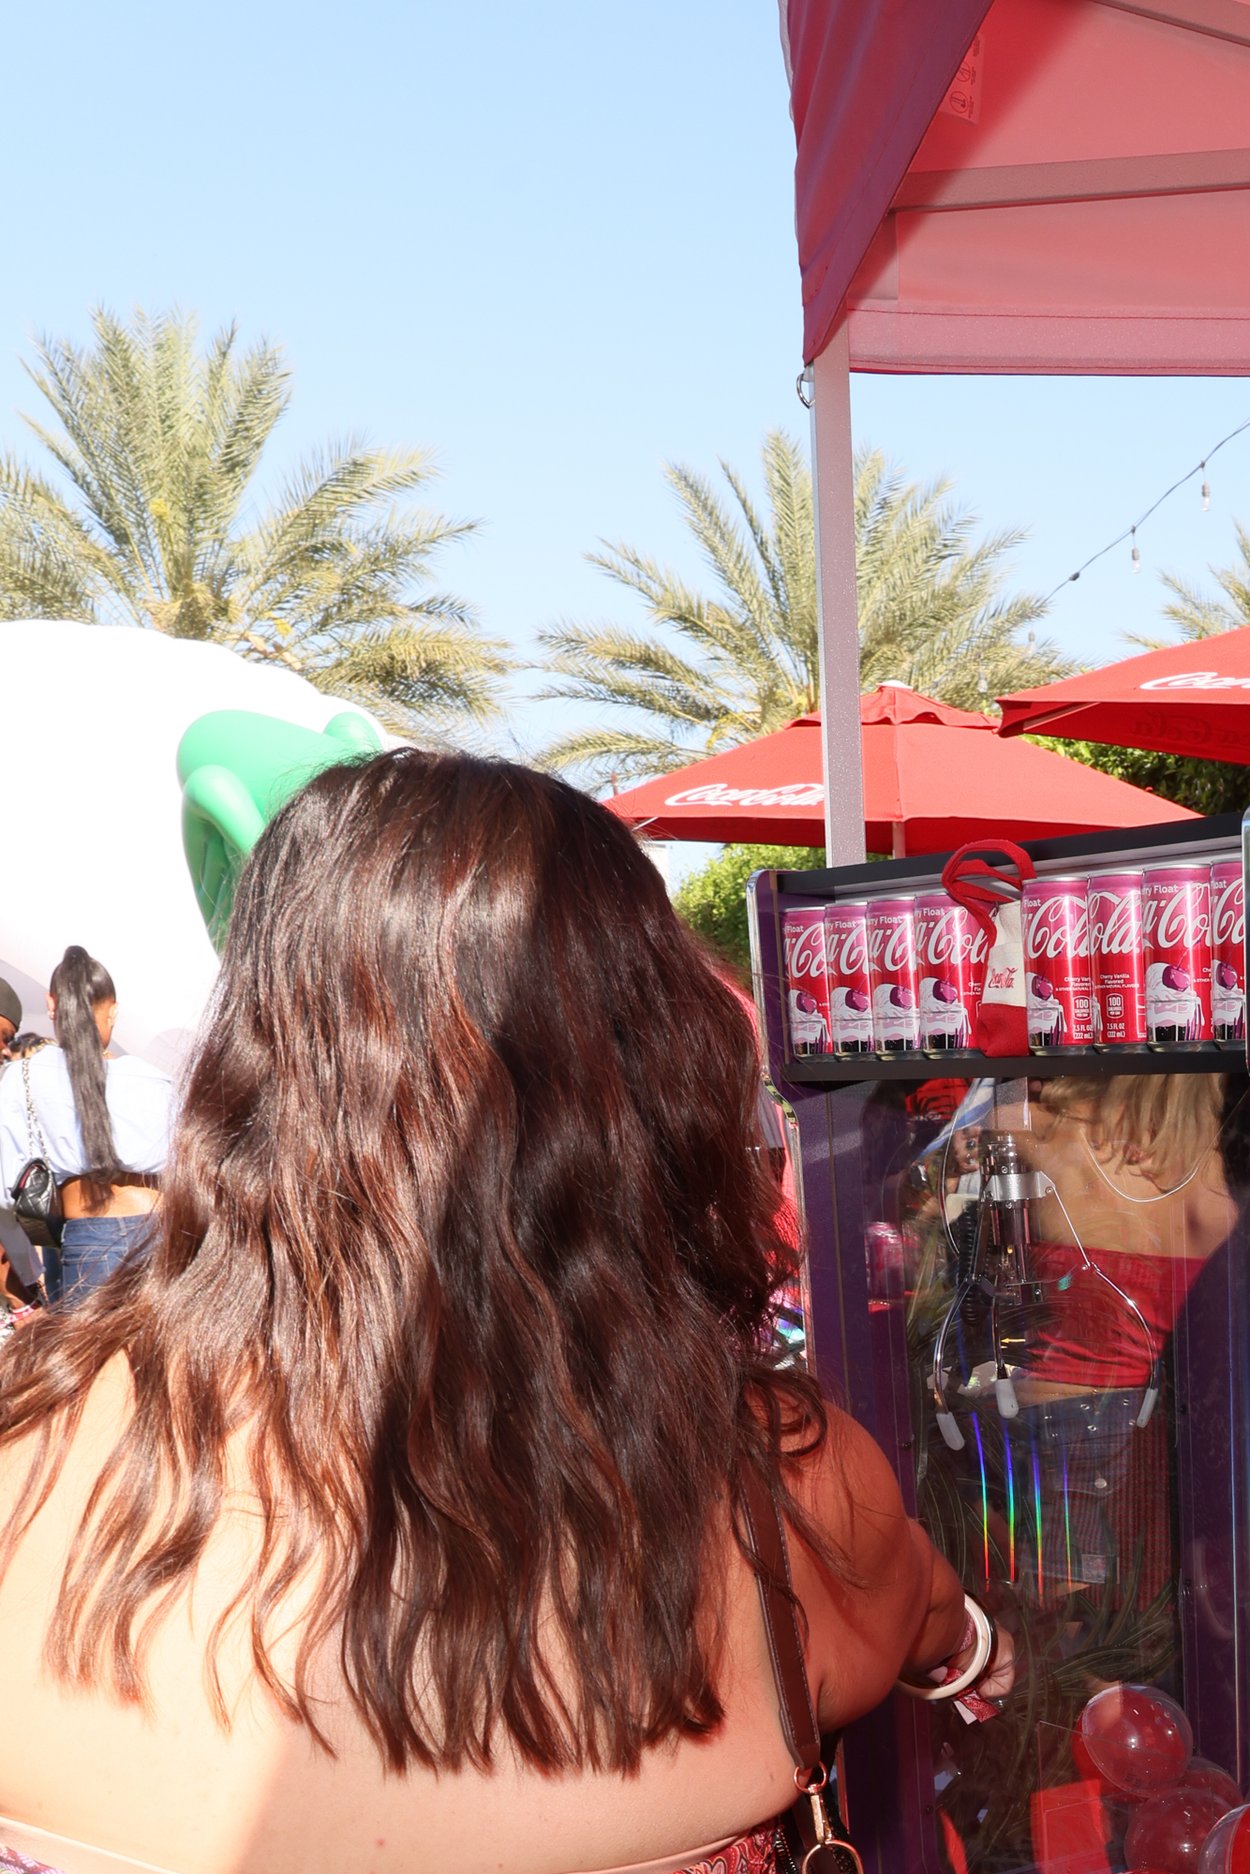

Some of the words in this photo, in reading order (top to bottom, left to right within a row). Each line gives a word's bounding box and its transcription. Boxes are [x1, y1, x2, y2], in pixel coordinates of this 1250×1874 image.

[1153, 884, 1180, 894] Float
[923, 908, 945, 916] Float
[879, 915, 903, 924] Float
[835, 920, 857, 929] Float
[1075, 999, 1088, 1009] 100
[1108, 997, 1121, 1006] 100
